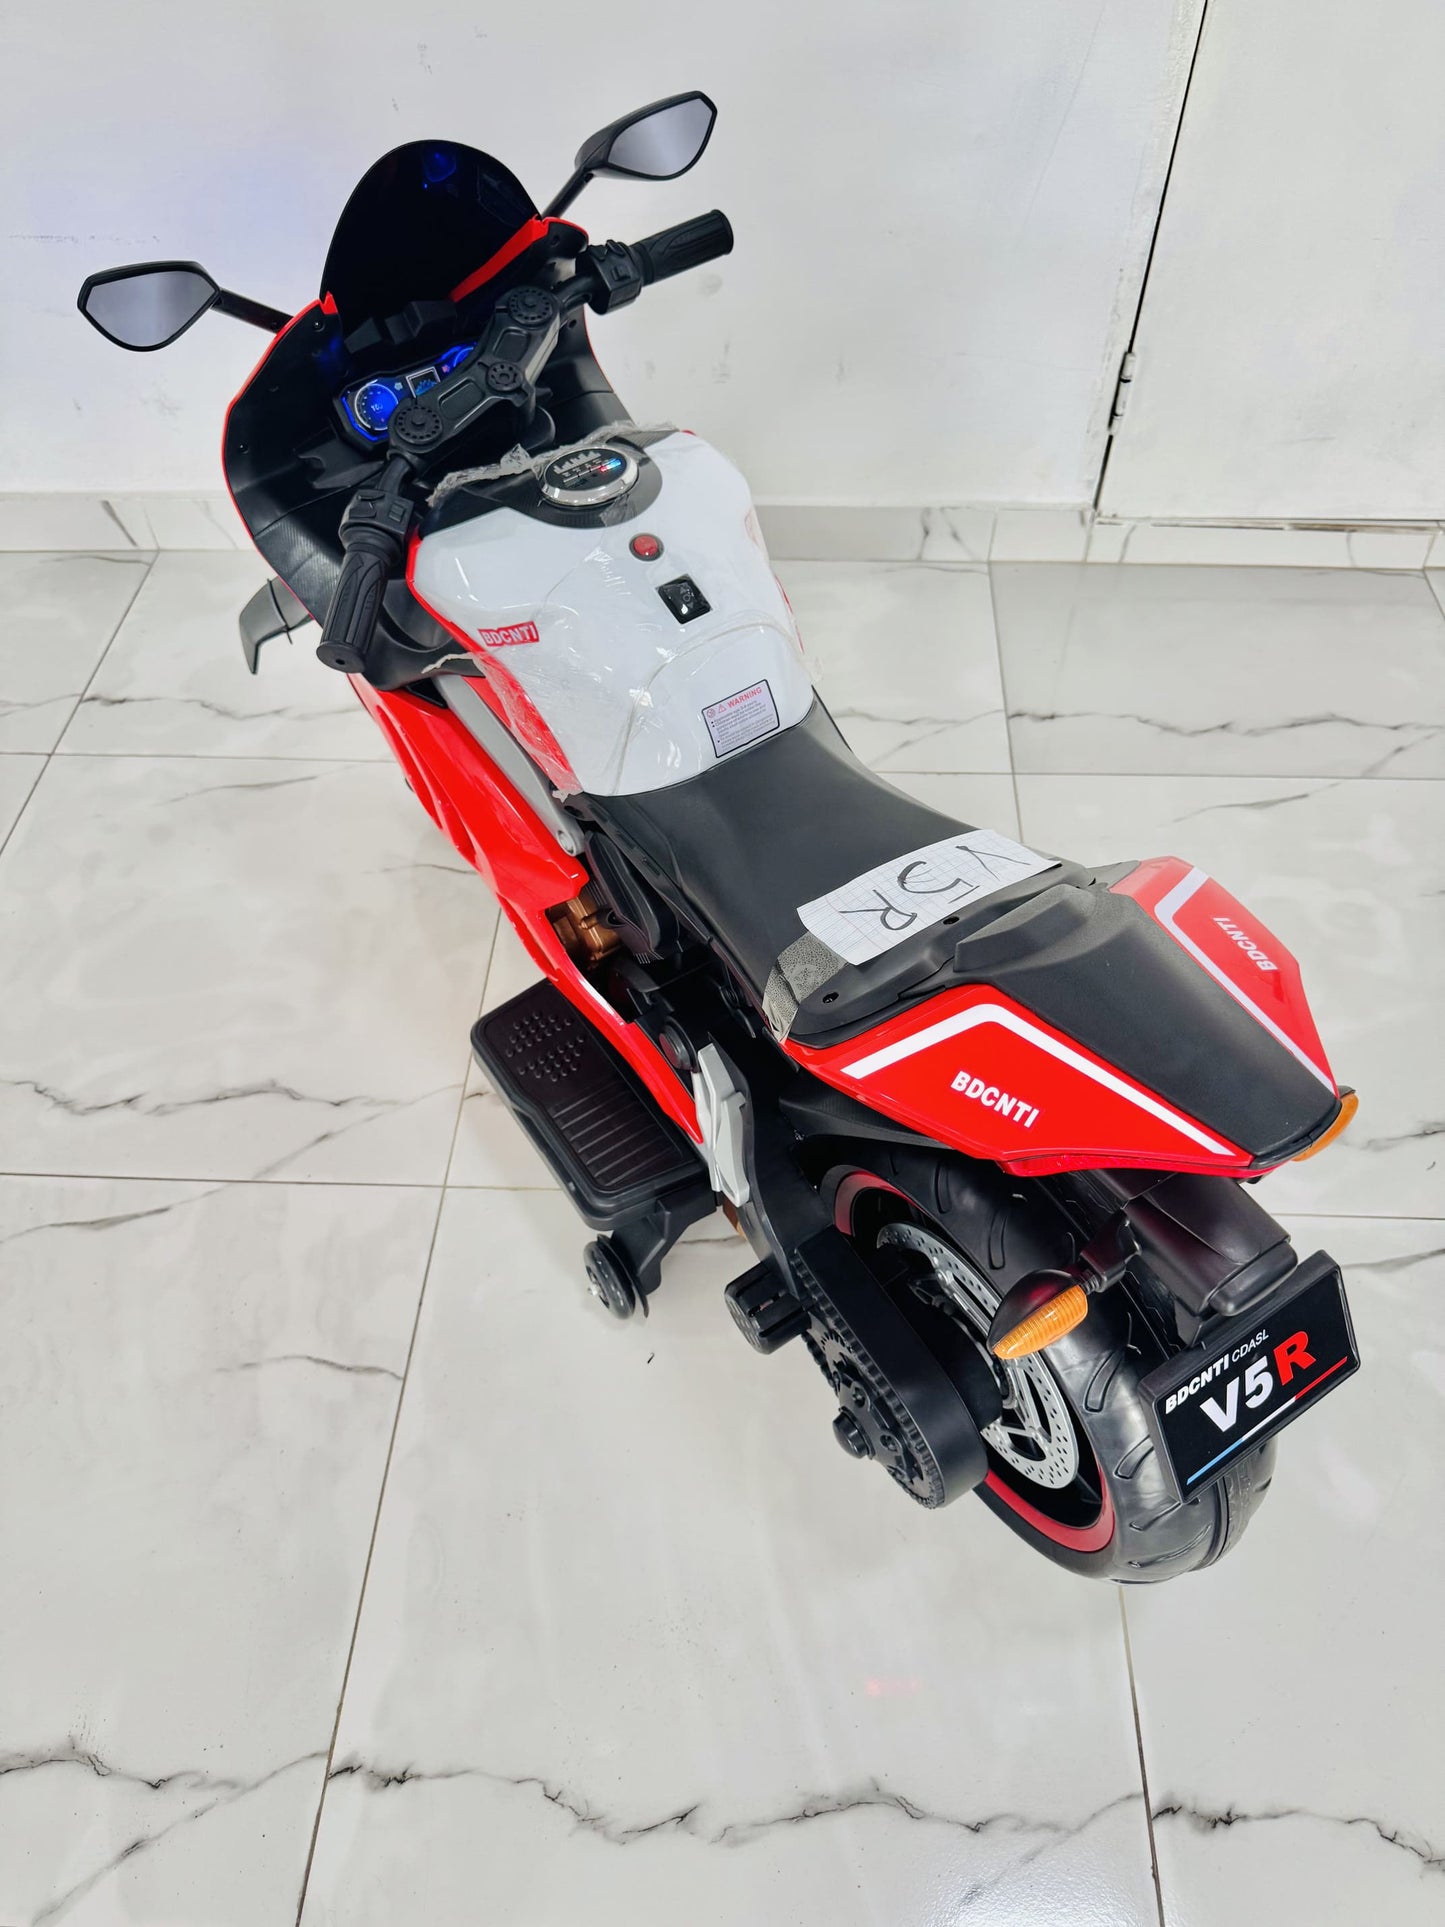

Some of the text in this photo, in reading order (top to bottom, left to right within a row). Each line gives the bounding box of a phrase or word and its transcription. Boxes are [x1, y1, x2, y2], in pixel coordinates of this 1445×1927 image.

[481, 624, 538, 644] BDCNTI
[727, 686, 762, 708] WARNING
[1212, 917, 1278, 971] BDCNTI
[950, 1070, 1040, 1128] BDCNTI
[1165, 1328, 1270, 1415] BDCNTI CDASL
[1199, 1330, 1317, 1433] V5R
